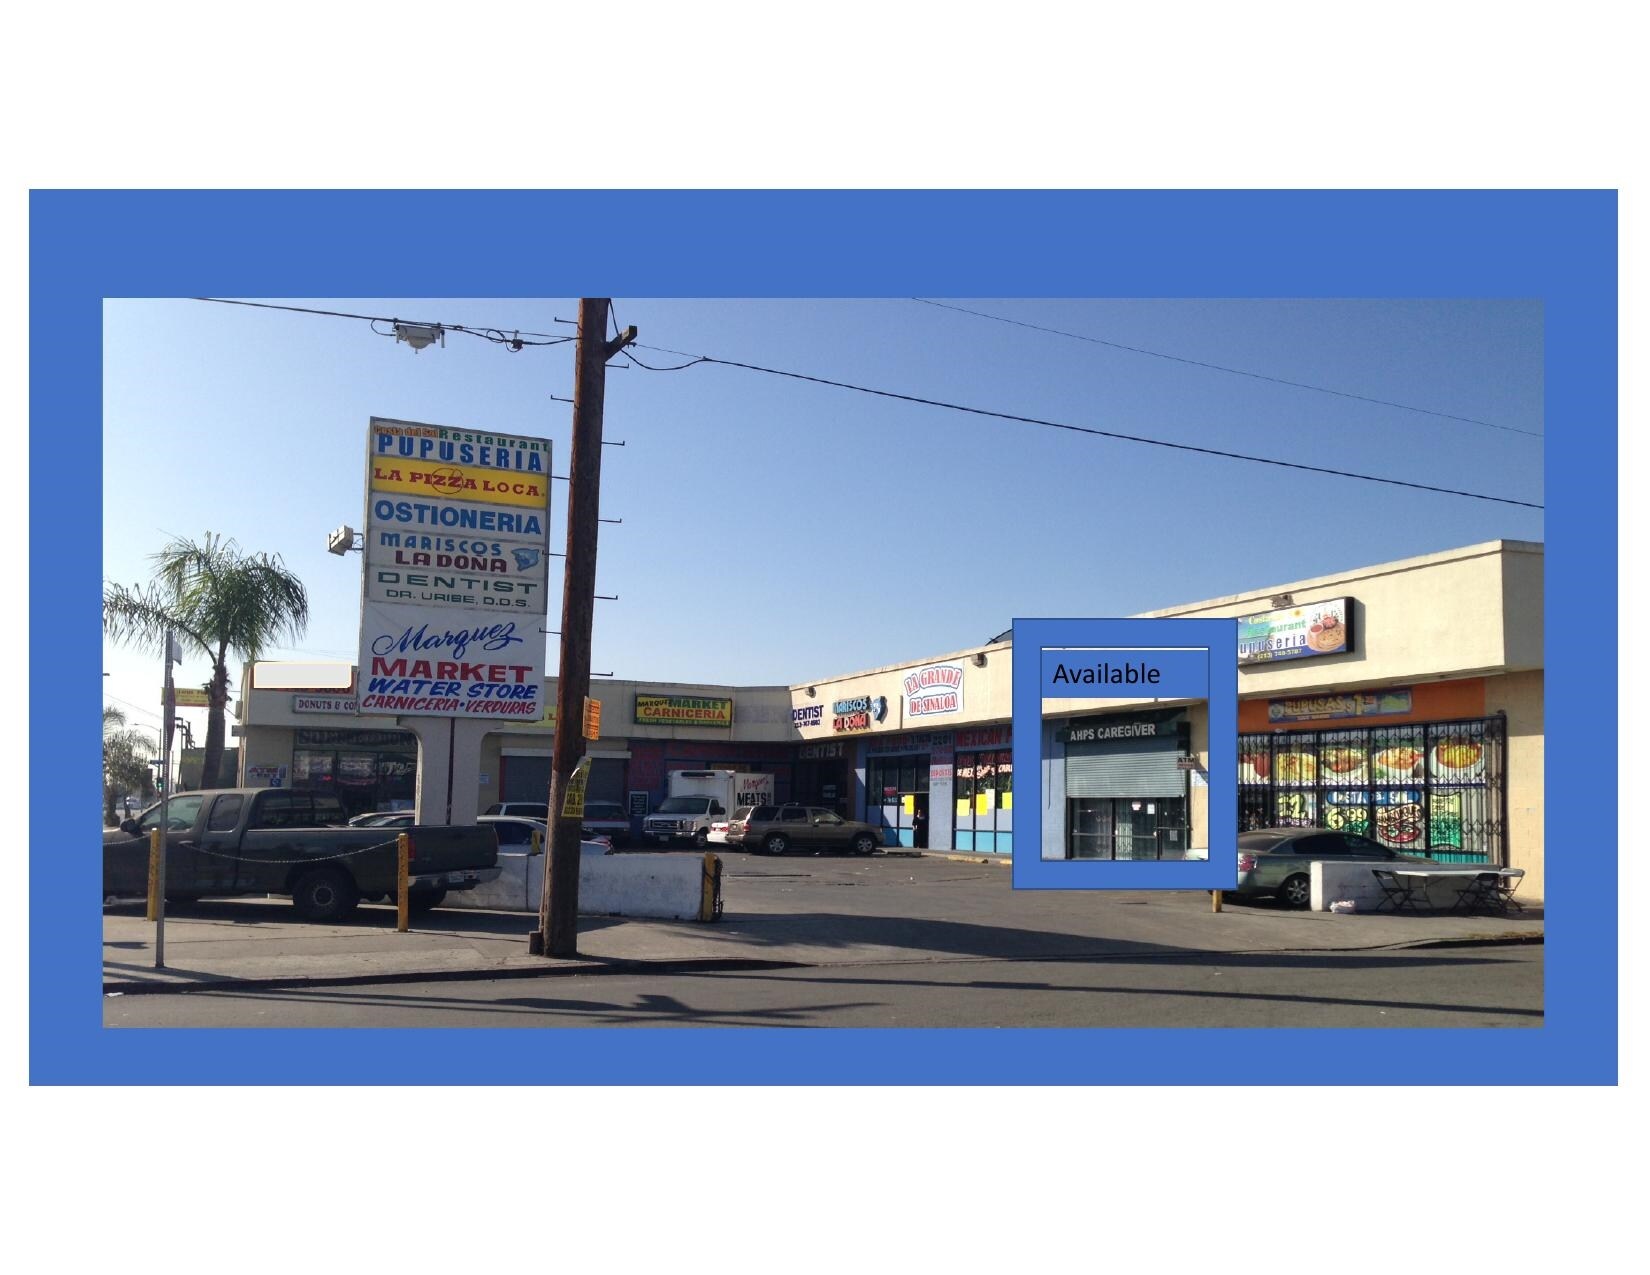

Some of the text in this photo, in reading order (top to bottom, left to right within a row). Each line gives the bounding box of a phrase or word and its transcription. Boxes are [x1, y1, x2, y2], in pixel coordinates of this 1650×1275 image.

[438, 428, 549, 452] Restaurant
[378, 434, 542, 472] PUPUSERIA
[374, 467, 402, 482] LA
[409, 471, 478, 490] PIZZA
[374, 499, 542, 536] OSTIONERIA
[380, 532, 502, 557] MARISCOS
[395, 550, 431, 566] LA
[377, 571, 538, 595] DENTIST
[386, 589, 531, 608] DR. URIBE, D.D.S.
[371, 621, 524, 660] Marquez
[371, 656, 533, 683] MARKET
[367, 677, 538, 699] WATER STORE
[904, 666, 962, 697] LA GRANDE
[298, 699, 332, 710] DONUTS
[643, 707, 725, 719] CARNICERIA
[670, 697, 728, 709] MARKET
[792, 705, 824, 720] DENTIST
[909, 692, 958, 716] DE SINALOA
[1070, 723, 1156, 741] AHPS CAREGIVER
[737, 792, 767, 806] MEATS
